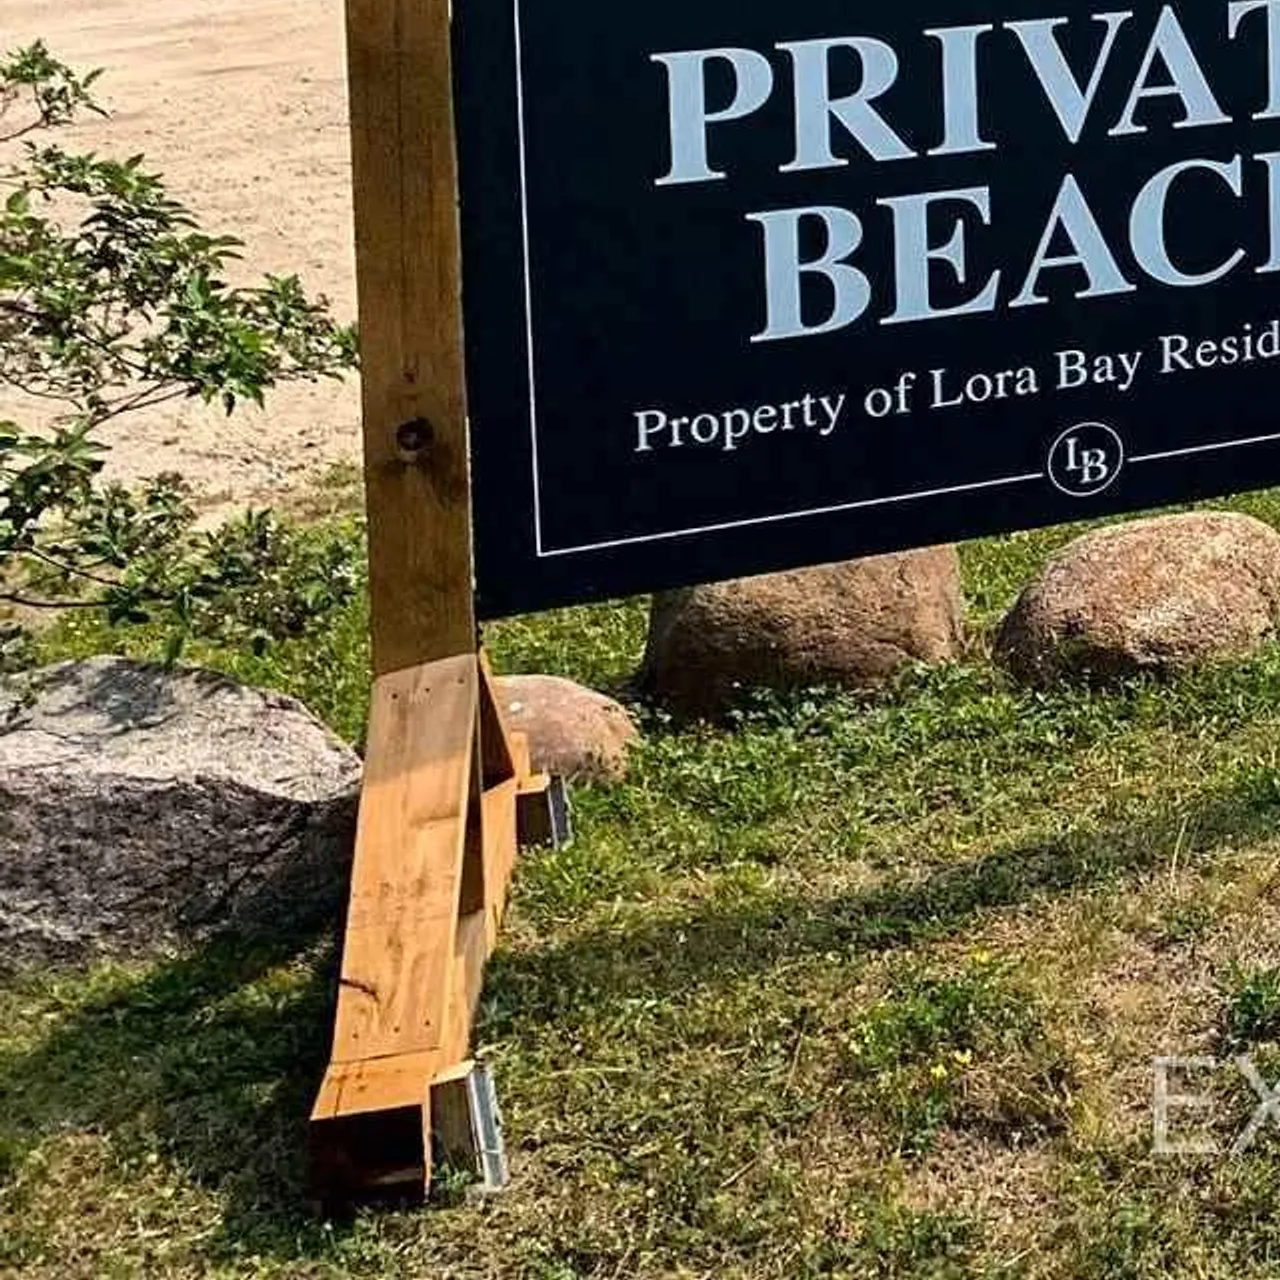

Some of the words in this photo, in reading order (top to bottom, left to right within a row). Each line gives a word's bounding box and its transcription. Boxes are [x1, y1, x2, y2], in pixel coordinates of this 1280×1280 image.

[633, 393, 846, 452] Property
[864, 371, 917, 418] of
[929, 366, 1039, 408] Lora
[1054, 349, 1143, 391] Bay
